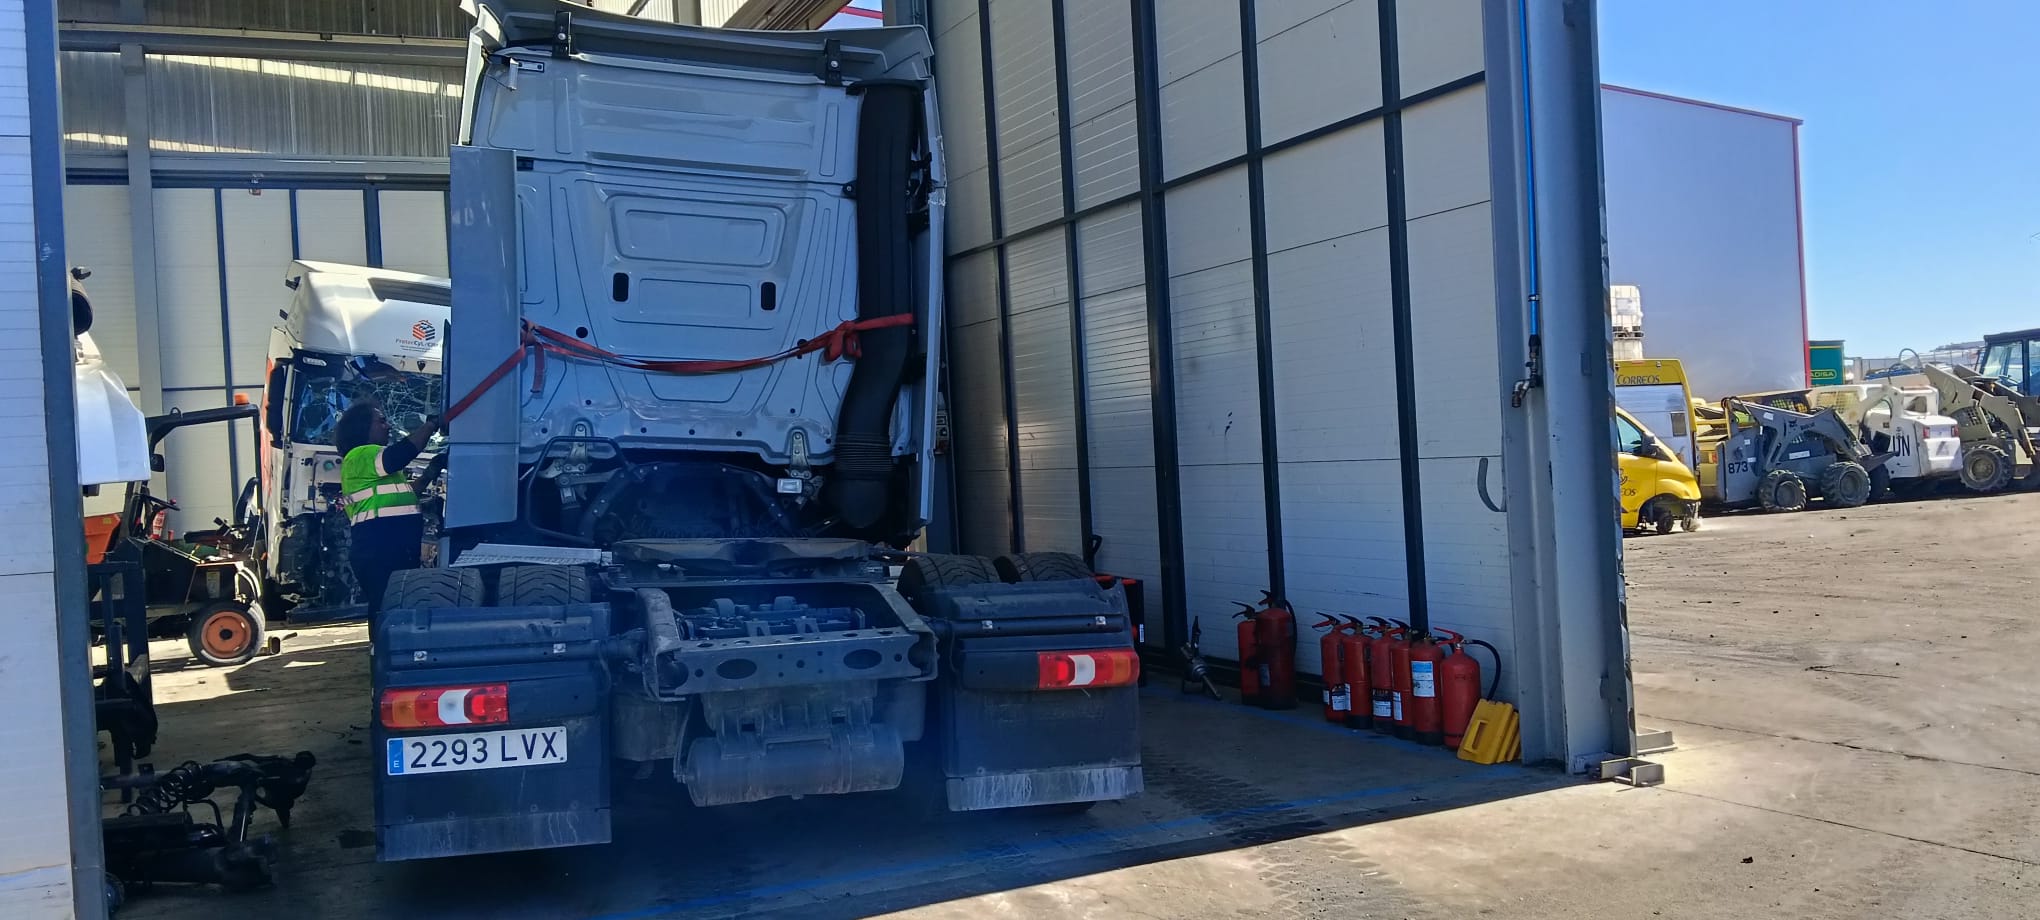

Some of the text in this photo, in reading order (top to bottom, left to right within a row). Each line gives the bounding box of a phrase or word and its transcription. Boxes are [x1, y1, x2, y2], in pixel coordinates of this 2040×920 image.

[1892, 434, 1911, 457] UN
[1728, 461, 1749, 474] 873
[410, 737, 488, 768] 2293
[501, 731, 558, 762] LVX
